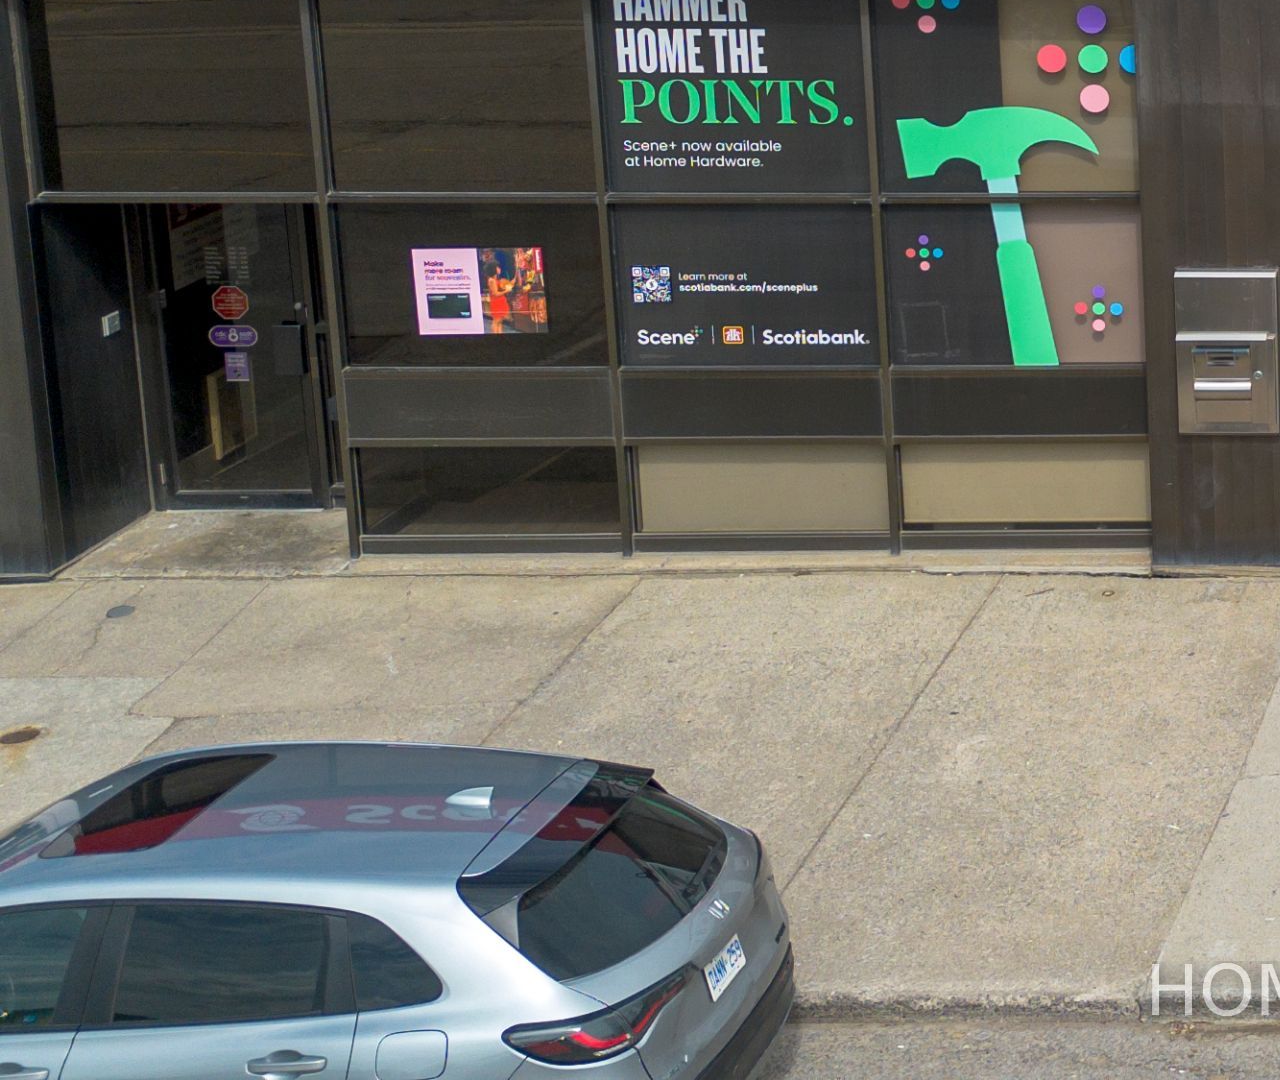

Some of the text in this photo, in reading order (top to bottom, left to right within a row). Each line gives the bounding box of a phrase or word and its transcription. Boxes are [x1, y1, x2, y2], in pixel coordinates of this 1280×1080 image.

[615, 27, 768, 74] HOME THE
[617, 79, 853, 126] POINTS.
[623, 140, 782, 152] Scene+ now available
[624, 156, 764, 167] at Home Hardware.
[678, 272, 706, 281] Learn
[736, 273, 748, 281] at
[679, 281, 818, 294] scotiabank.com/sceneplus
